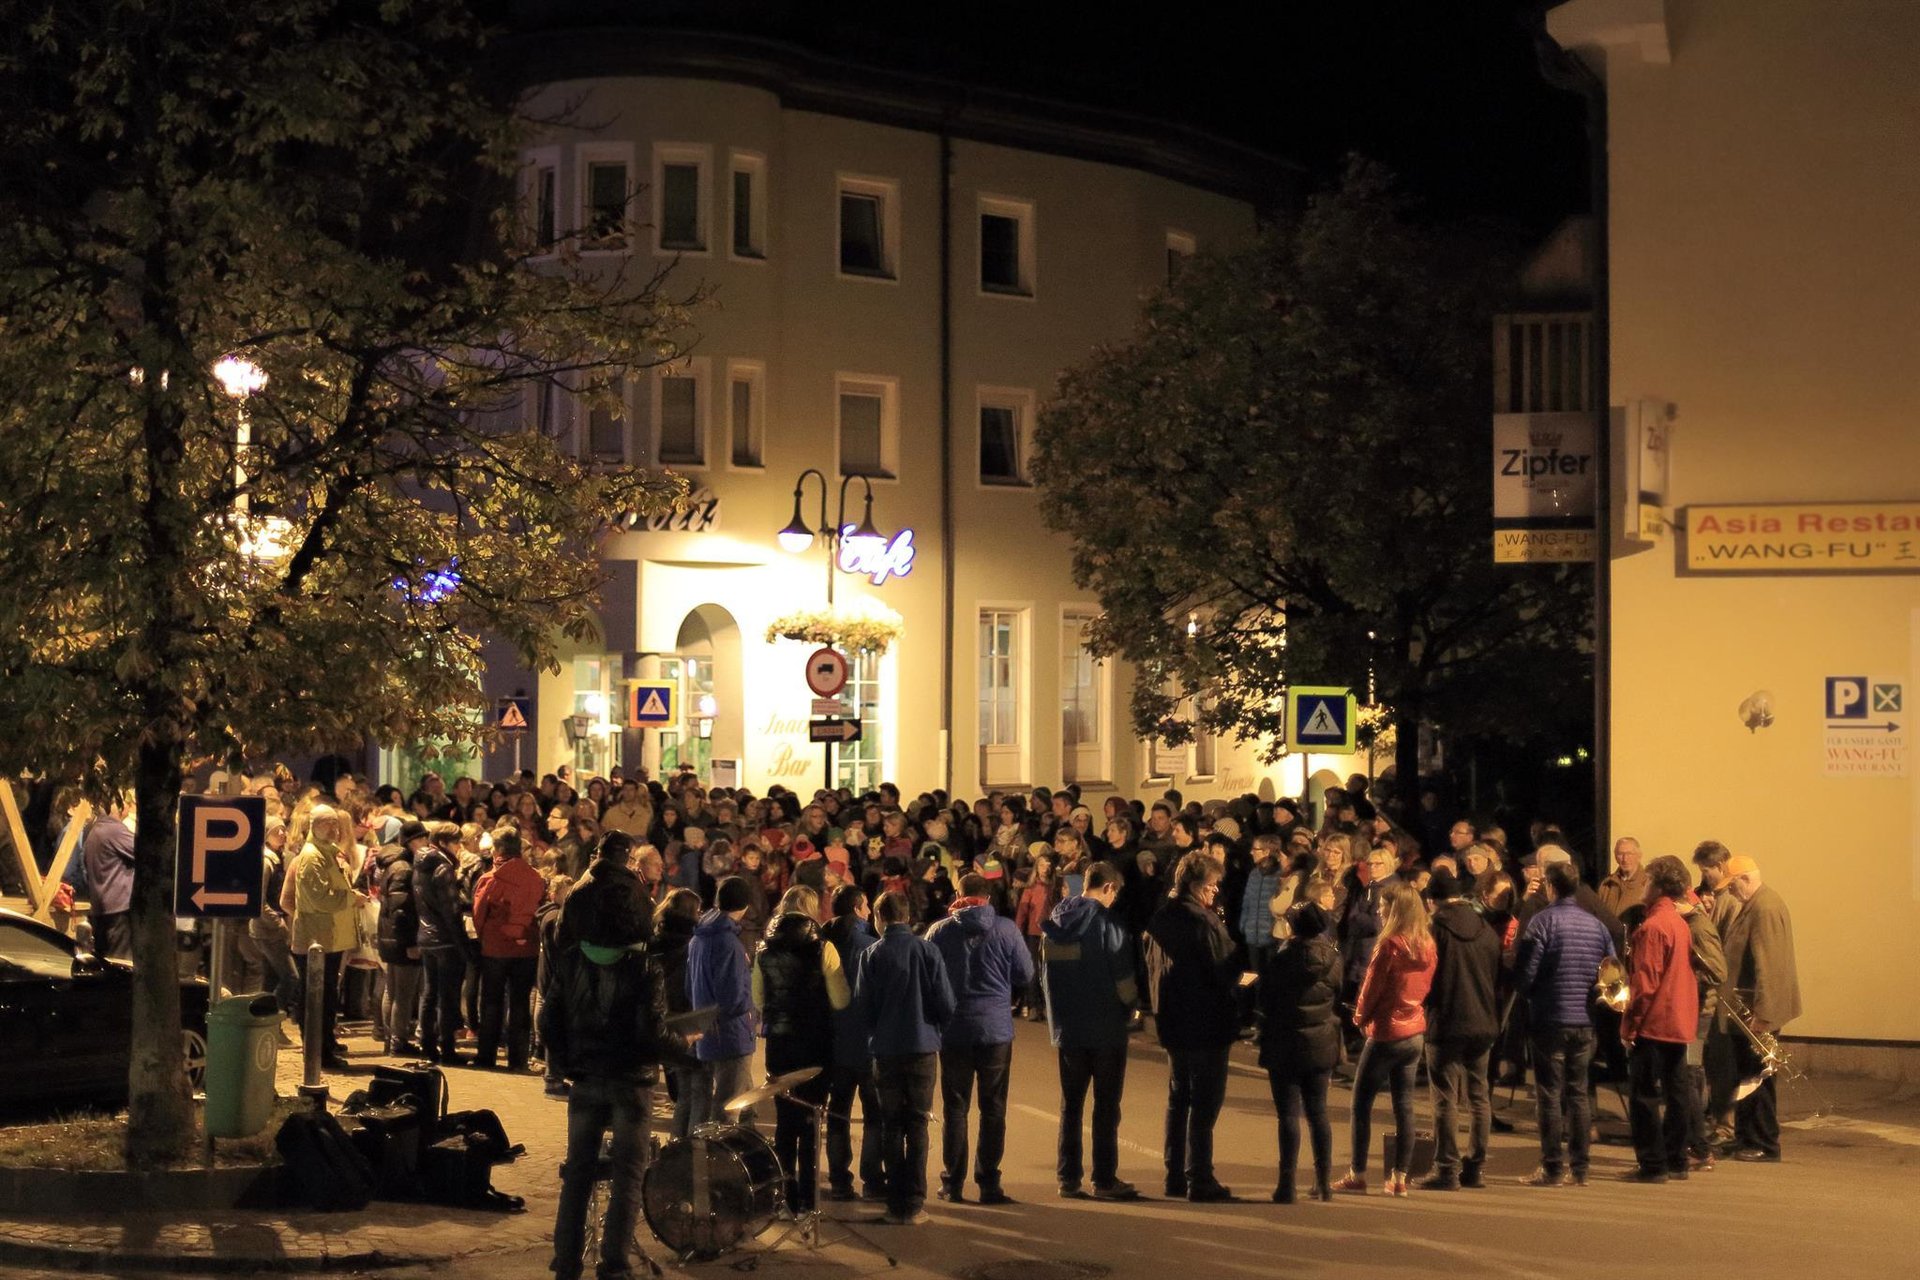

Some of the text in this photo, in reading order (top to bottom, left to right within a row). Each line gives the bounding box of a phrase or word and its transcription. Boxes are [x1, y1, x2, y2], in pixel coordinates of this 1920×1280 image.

[1501, 449, 1592, 482] Zipfer
[1697, 513, 1920, 534] Asia Resta
[1834, 681, 1860, 715] P
[767, 742, 812, 777] Bar
[192, 807, 251, 883] P
